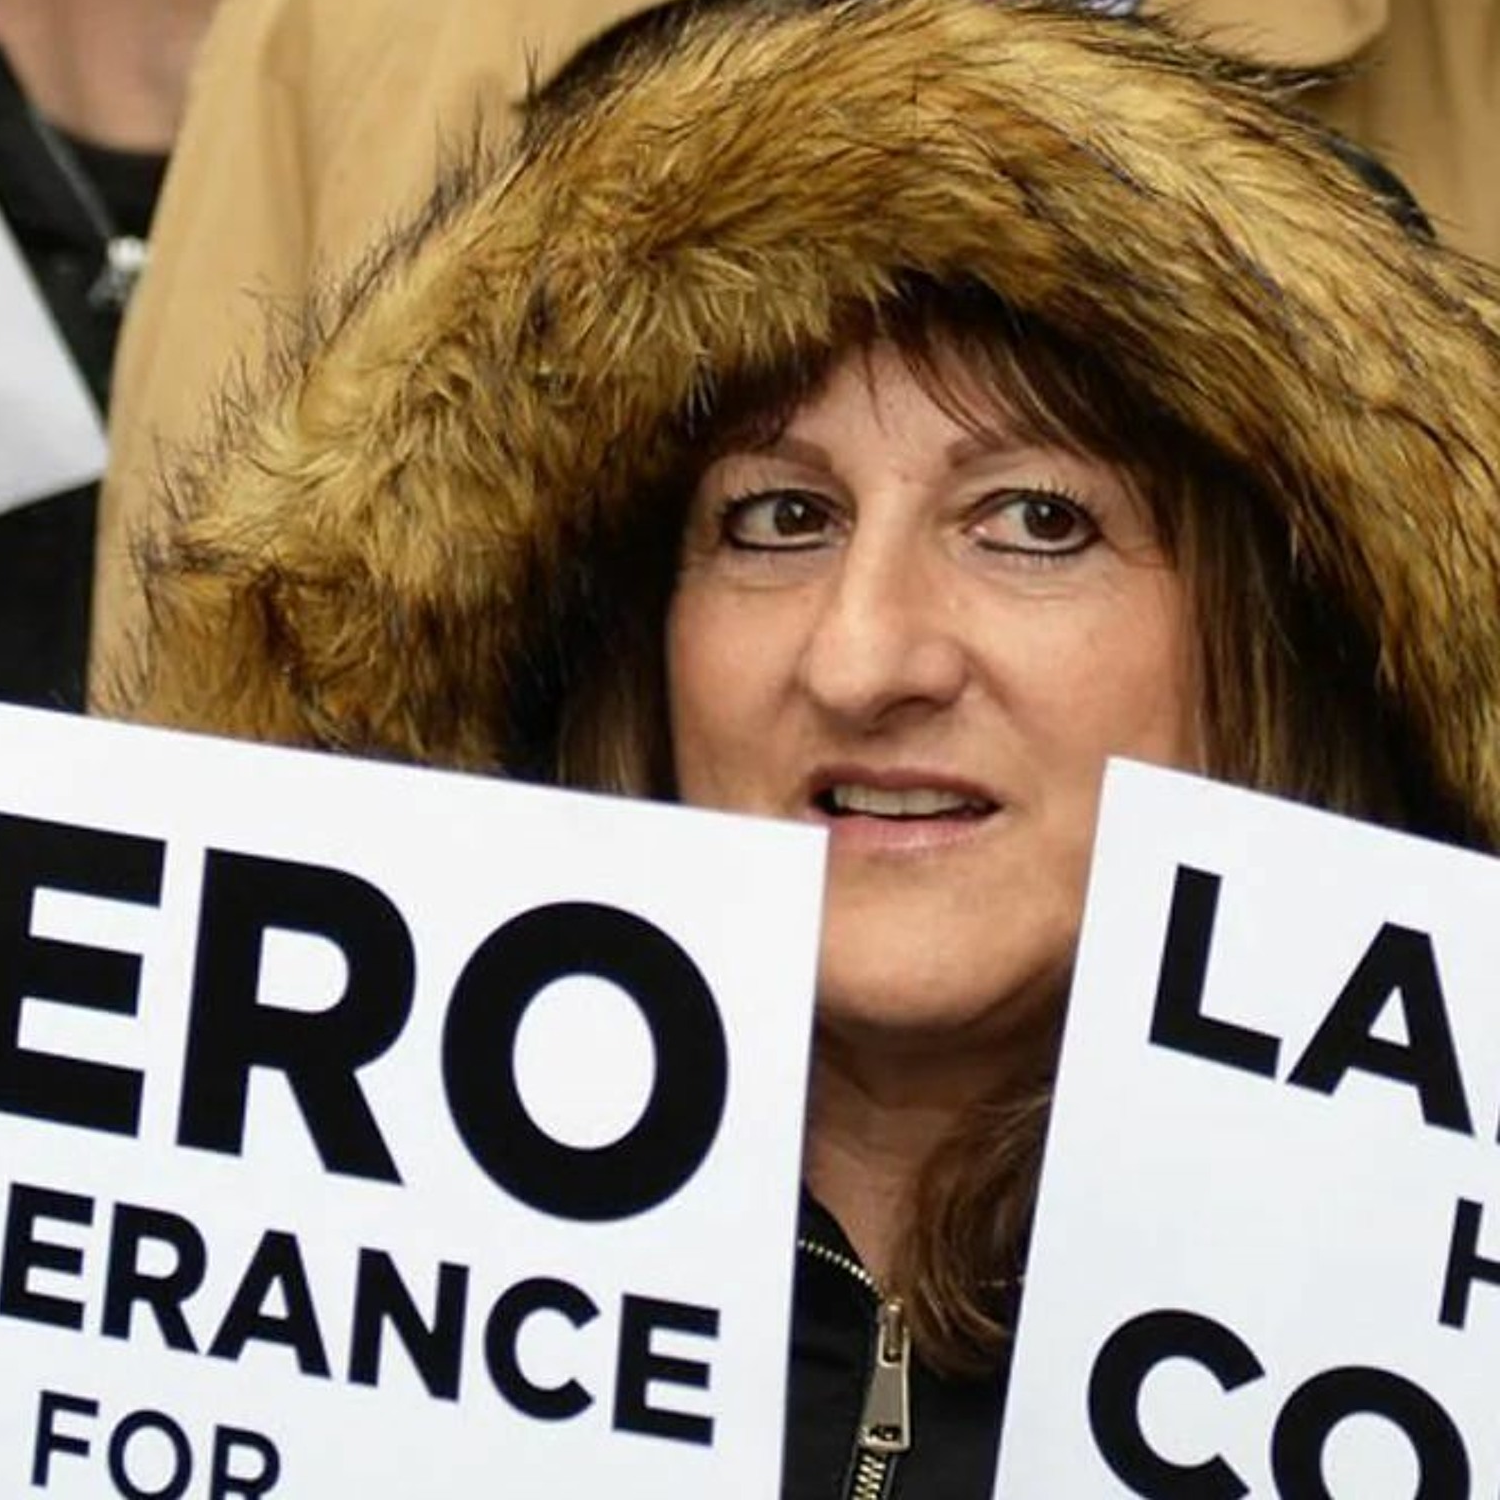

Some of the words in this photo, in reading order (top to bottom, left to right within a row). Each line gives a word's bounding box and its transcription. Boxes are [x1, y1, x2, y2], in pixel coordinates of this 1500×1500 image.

[1148, 863, 1500, 1145] LA
[31, 1389, 281, 1500] FOR
[1087, 1308, 1500, 1500] CO
